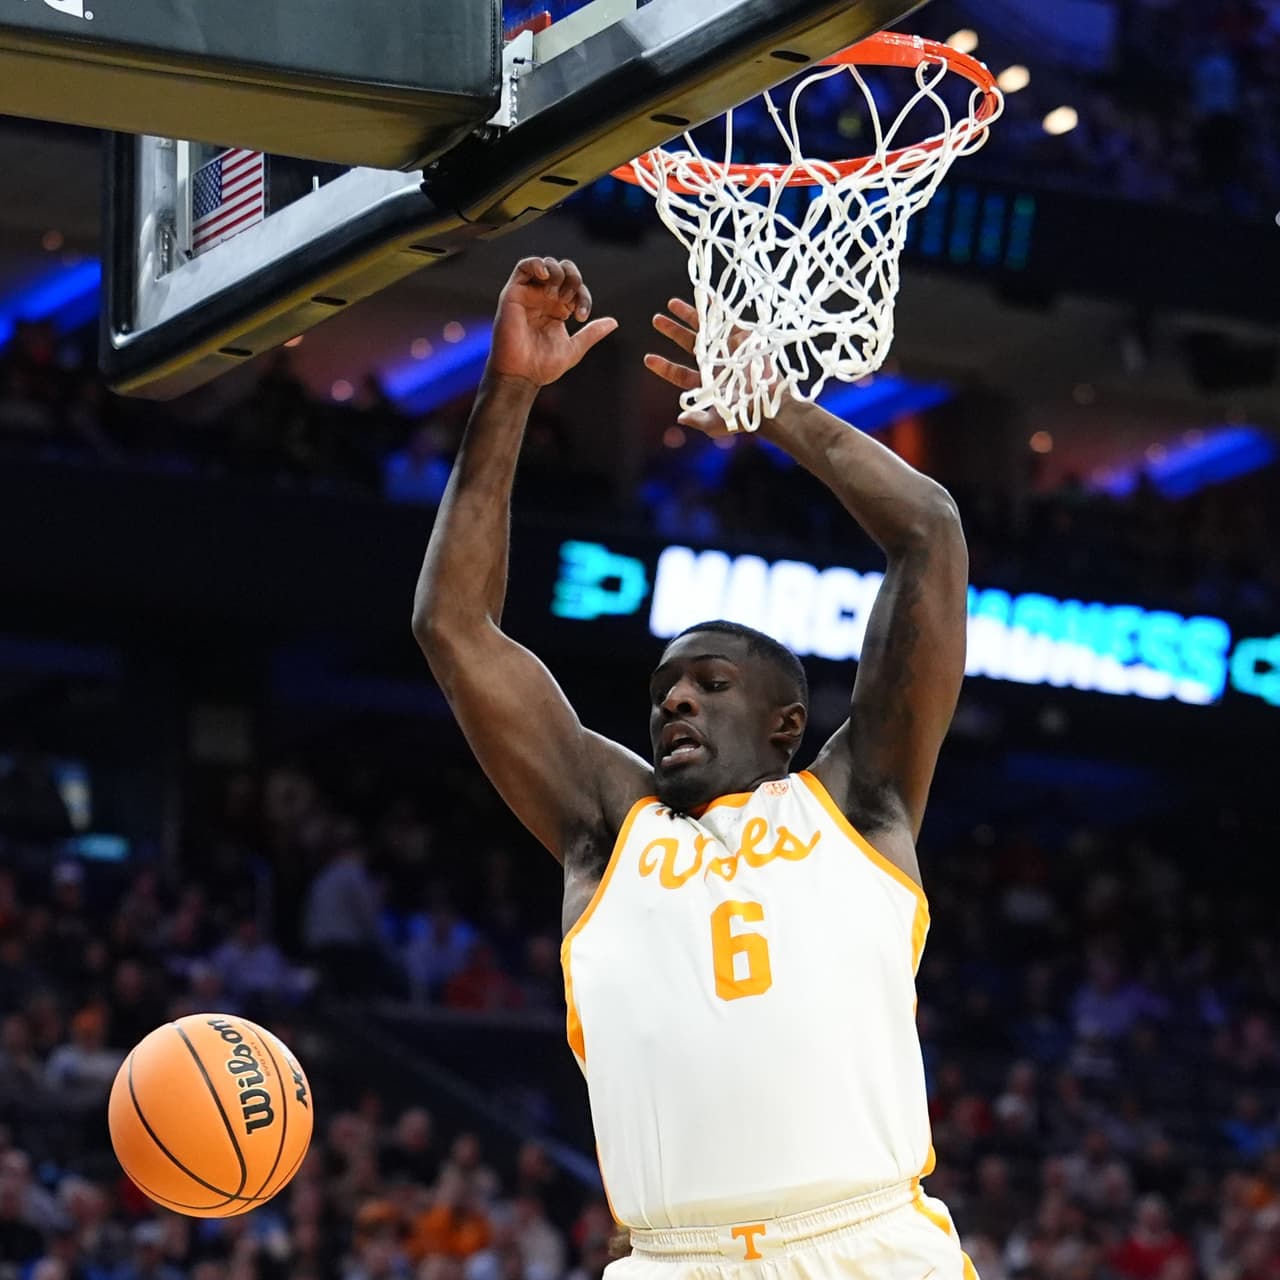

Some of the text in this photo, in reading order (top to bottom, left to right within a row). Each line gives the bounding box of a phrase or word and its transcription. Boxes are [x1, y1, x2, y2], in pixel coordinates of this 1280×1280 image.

[649, 545, 1231, 705] MARC ADNESS
[639, 817, 821, 889] Vols
[710, 900, 773, 1002] 6
[207, 1018, 275, 1135] Wilson
[731, 1223, 766, 1261] T
